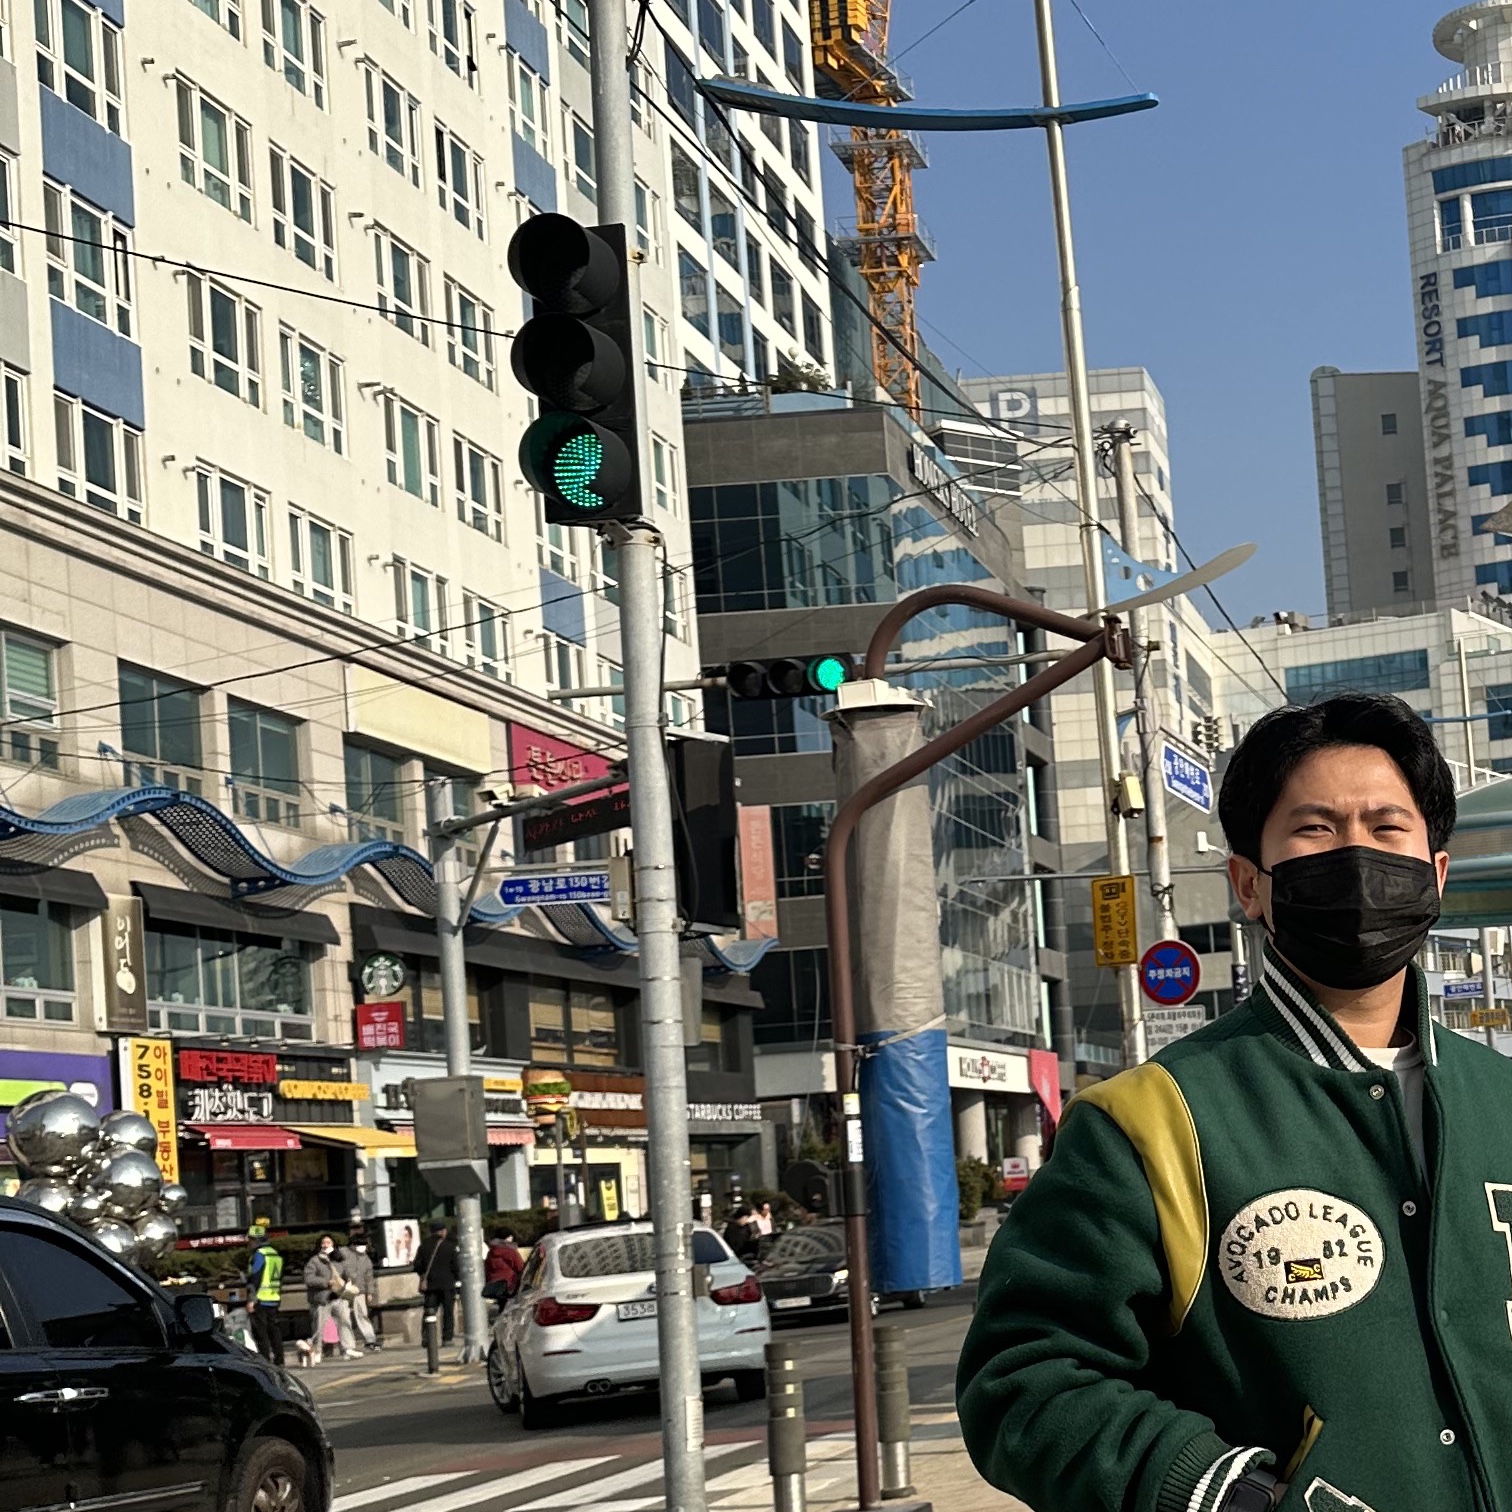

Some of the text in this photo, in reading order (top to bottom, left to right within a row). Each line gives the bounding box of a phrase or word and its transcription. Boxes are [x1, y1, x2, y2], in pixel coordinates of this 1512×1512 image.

[998, 391, 1031, 430] P
[1419, 271, 1460, 559] RESORT AQUA PALACE
[1148, 966, 1191, 980] 주정차금지
[733, 1103, 762, 1120] COFFEE
[157, 1119, 175, 1177] 부동산
[1227, 1201, 1375, 1284] AVOCADO LEAGUE
[1253, 1239, 1349, 1270] 19 82
[1264, 1275, 1352, 1306] CHAMPS
